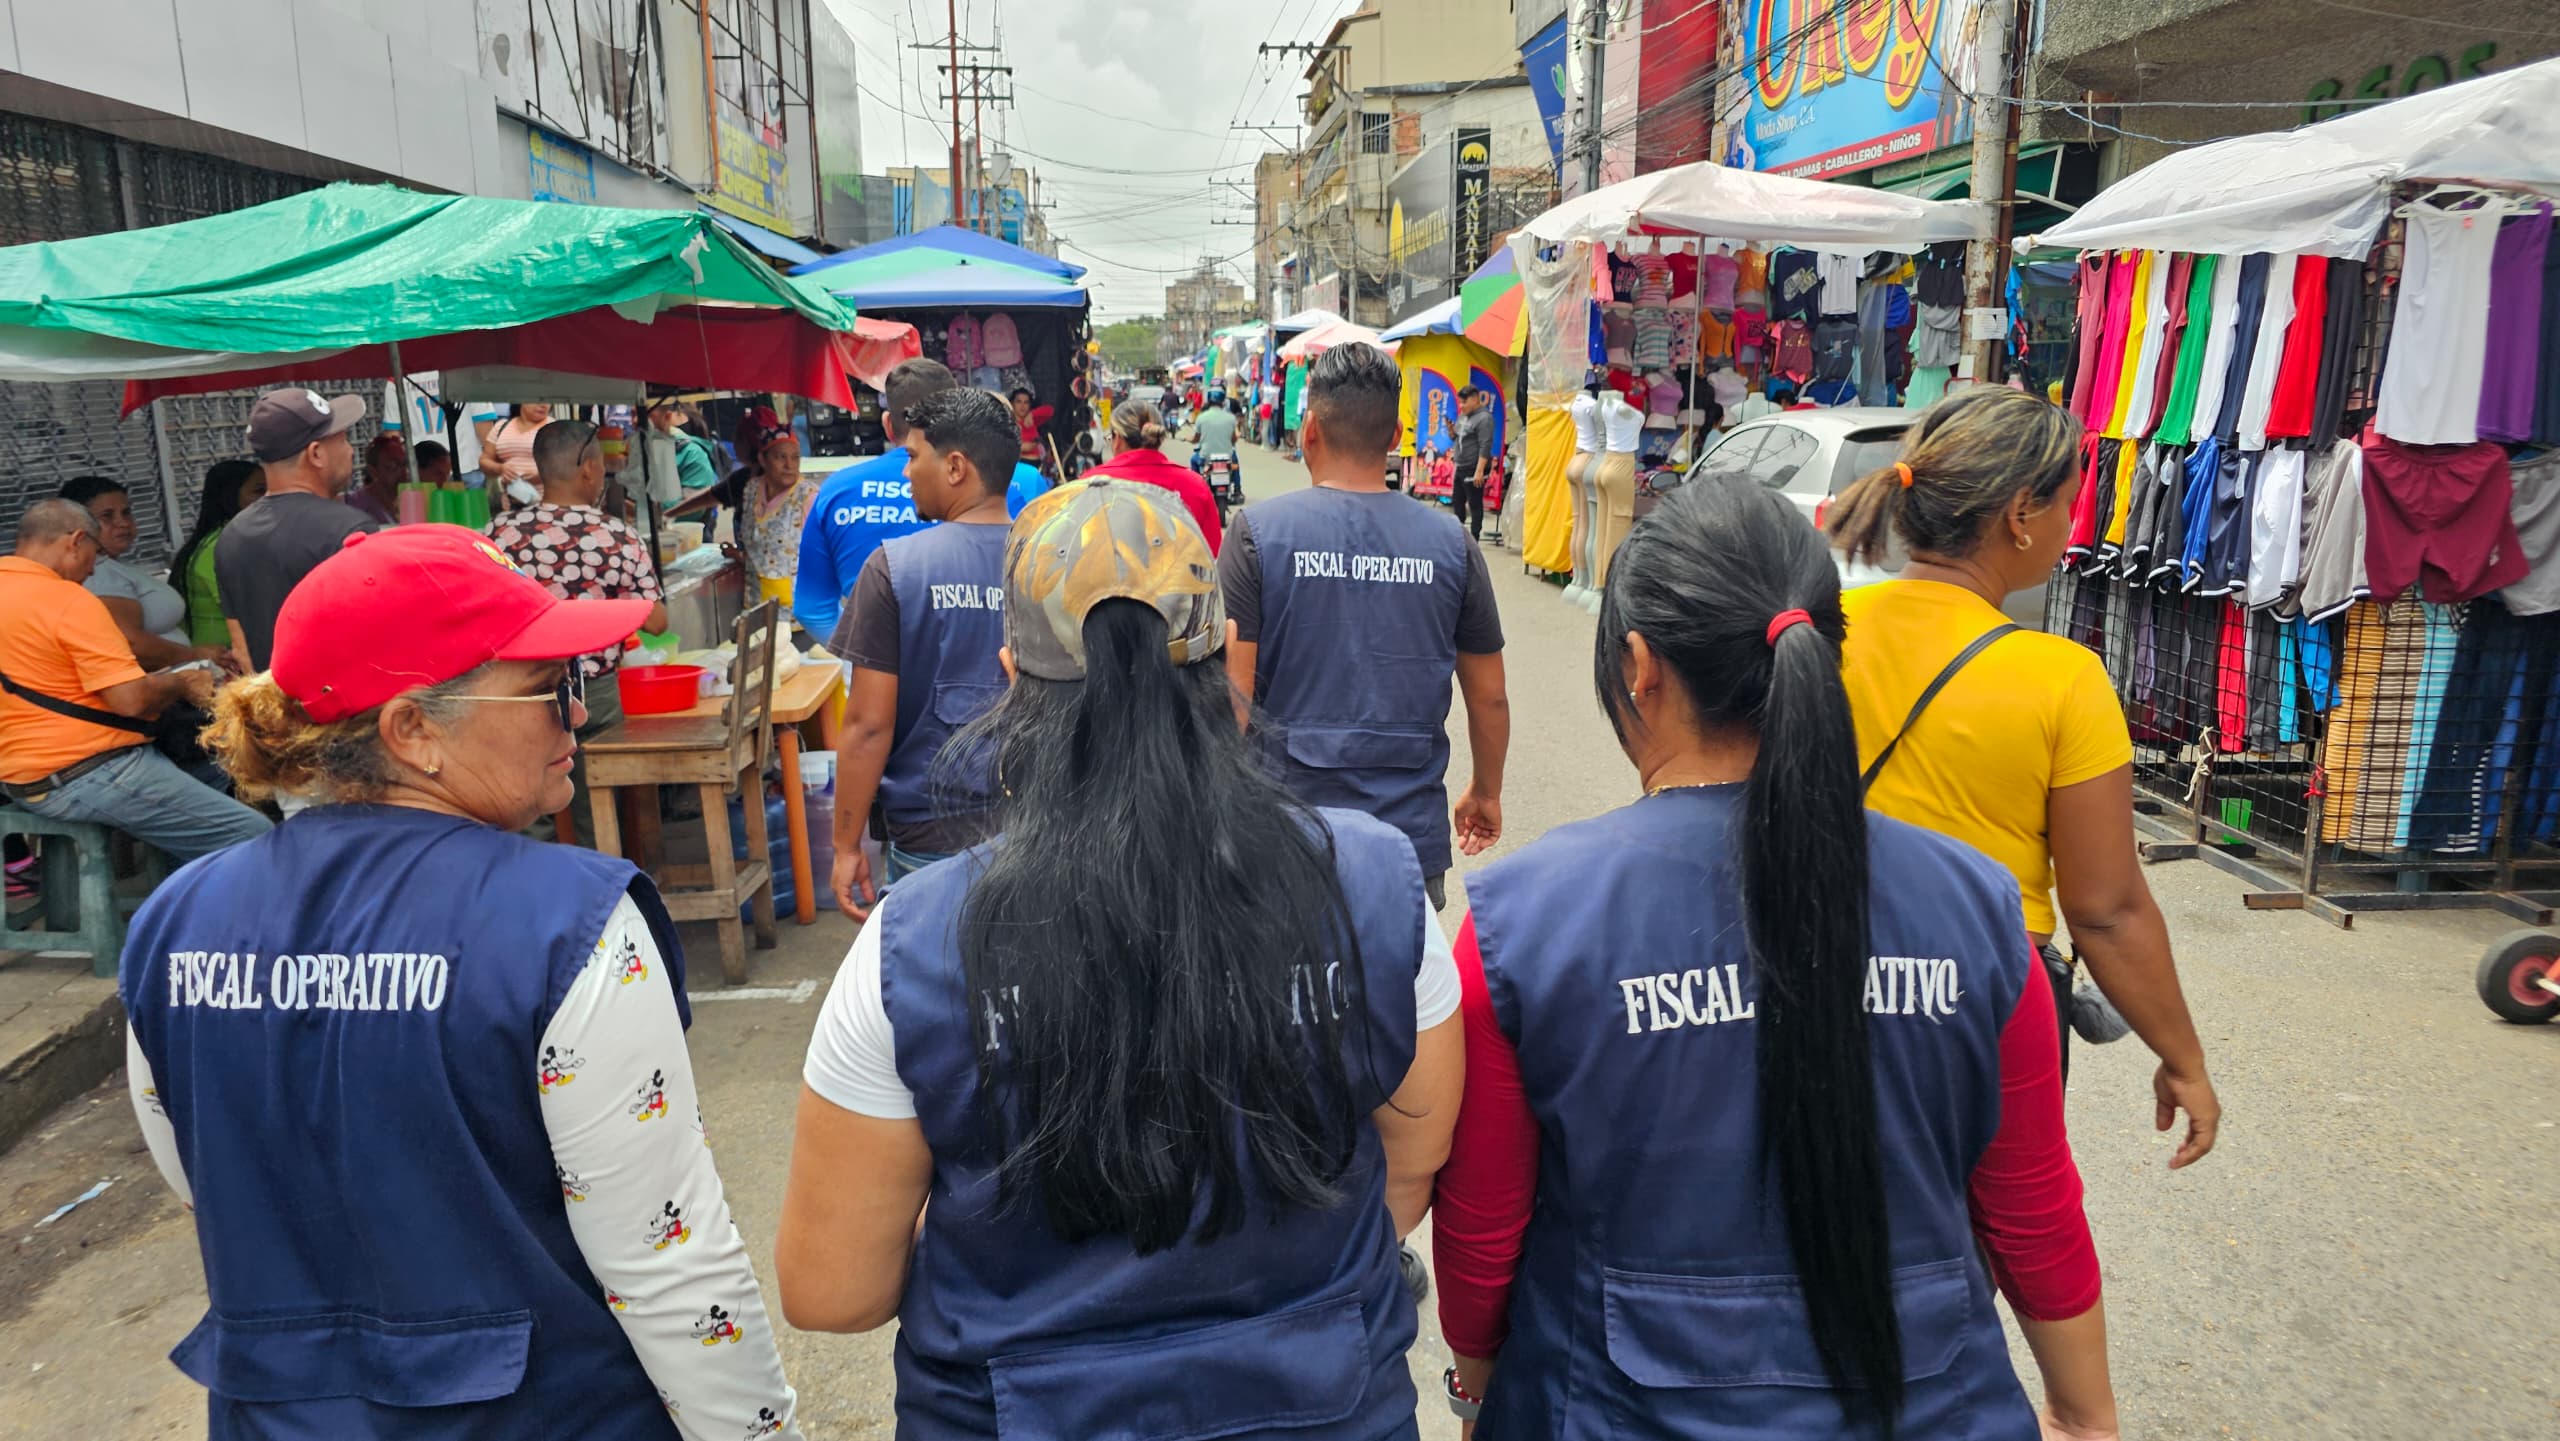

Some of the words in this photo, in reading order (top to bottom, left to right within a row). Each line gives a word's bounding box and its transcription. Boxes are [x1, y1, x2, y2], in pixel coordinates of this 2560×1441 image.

[1793, 162, 1821, 178] DAMAS
[1825, 144, 1883, 171] CABALLEROS
[1889, 132, 1922, 153] NIÑOS
[862, 481, 912, 498] FISC
[834, 504, 938, 526] OPERA
[1294, 552, 1347, 577] FISCAL
[1352, 555, 1434, 585] OPERATIVO
[930, 584, 983, 610] FISCAL
[986, 588, 1004, 610] OP
[169, 951, 262, 1009] FISCAL
[271, 953, 449, 1011] OPERATIVO
[1618, 964, 1755, 1034] FISCAL
[1863, 956, 1958, 1016] ATIVO
